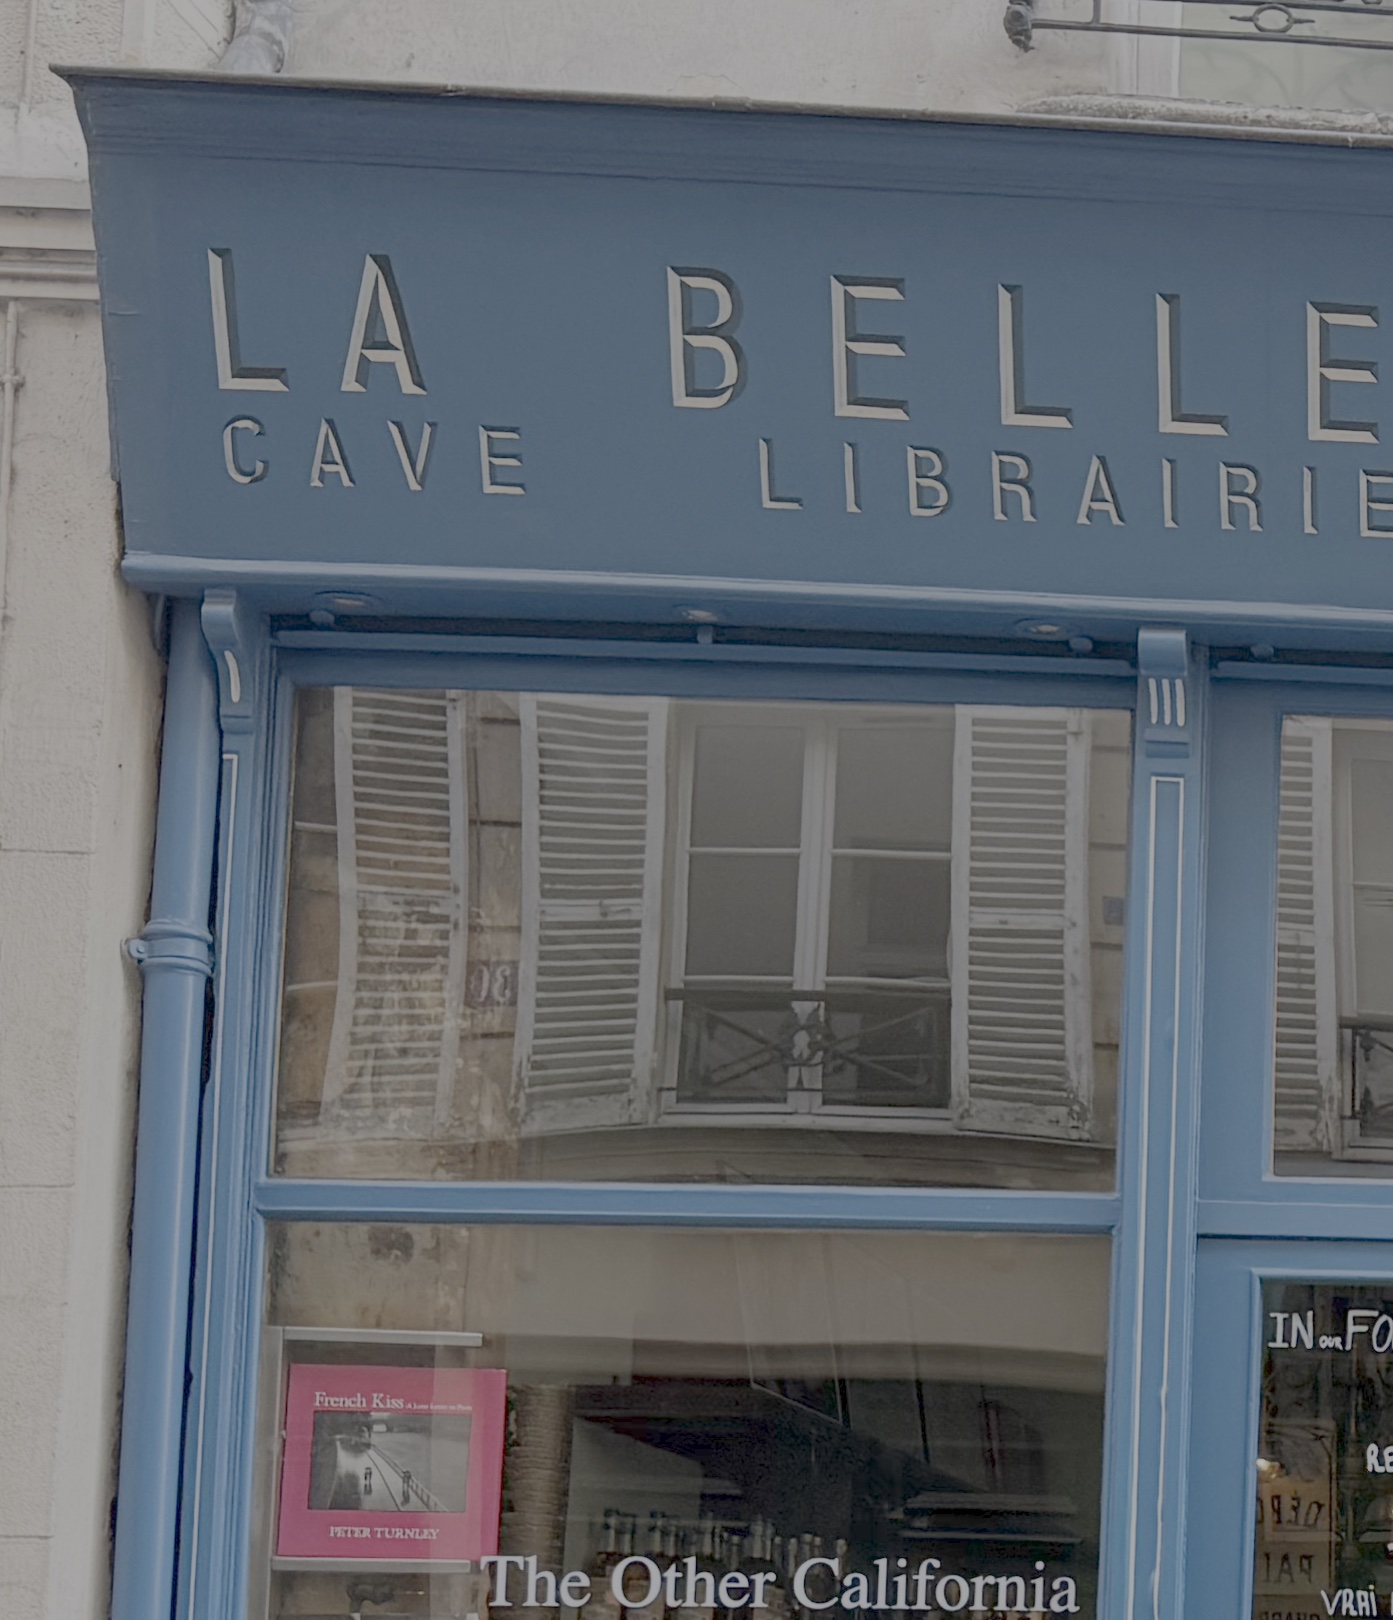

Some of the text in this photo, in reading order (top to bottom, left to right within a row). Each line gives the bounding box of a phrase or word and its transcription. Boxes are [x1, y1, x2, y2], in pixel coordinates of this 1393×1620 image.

[207, 246, 427, 395] LA
[666, 264, 1381, 446] BELLE
[222, 416, 526, 496] CAVE
[1268, 1311, 1315, 1350] IN
[314, 1391, 367, 1408] French
[371, 1392, 404, 1409] Kiss
[330, 1526, 440, 1541] PETER TURNLEY
[480, 1554, 1081, 1615] The Other California
